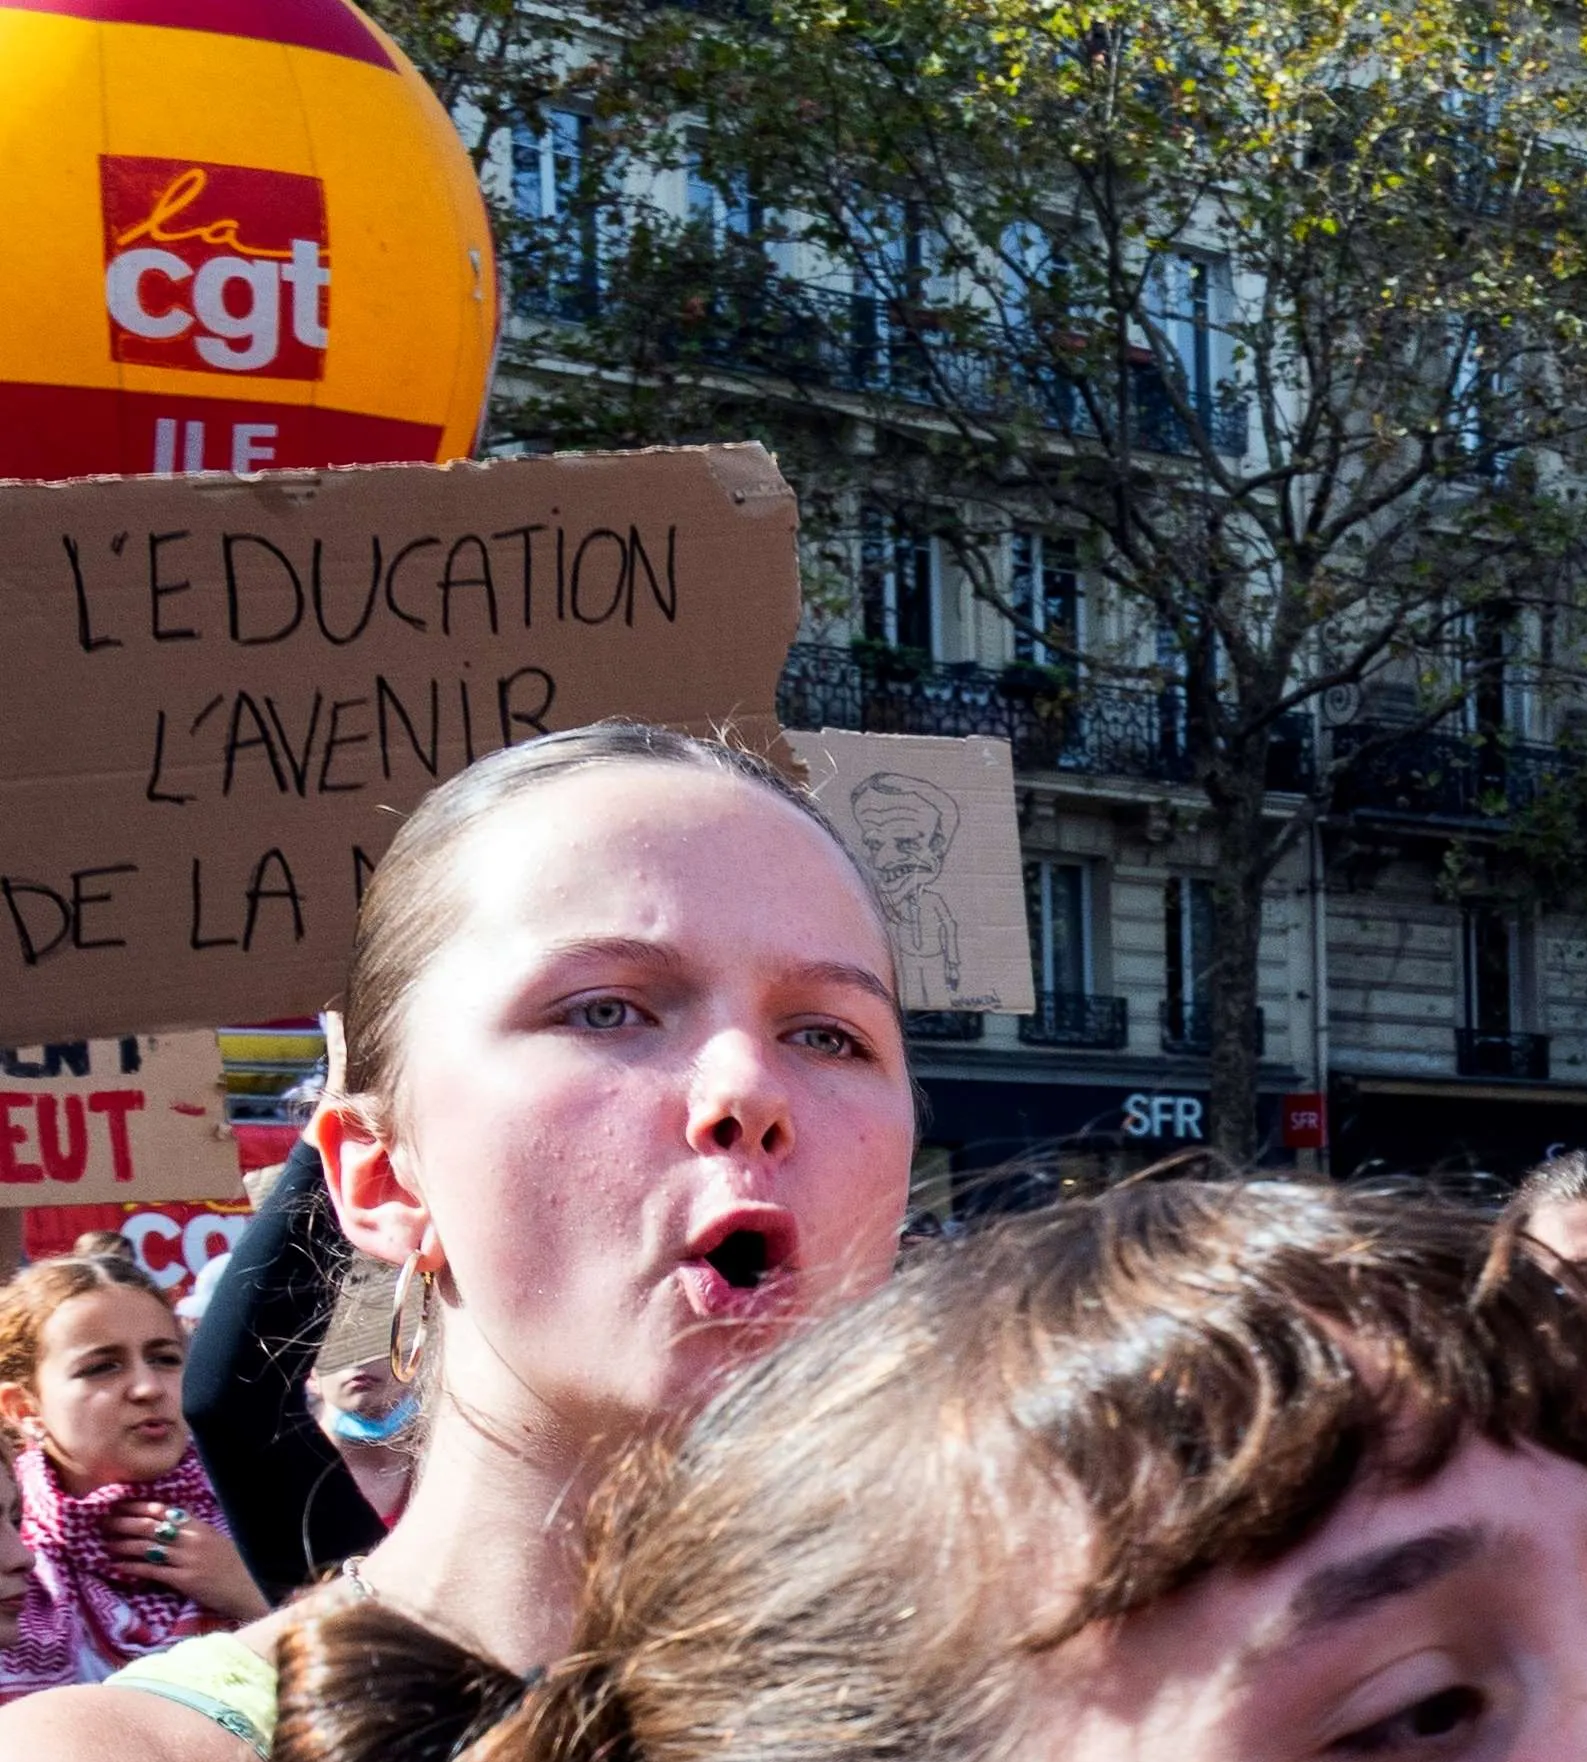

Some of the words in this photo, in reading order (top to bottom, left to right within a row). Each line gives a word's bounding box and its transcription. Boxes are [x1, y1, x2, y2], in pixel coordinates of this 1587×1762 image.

[117, 168, 330, 257] la
[106, 238, 330, 371] cgt
[62, 507, 677, 651] L'EDUCATION
[1, 864, 138, 966] DE
[190, 848, 305, 952] LA
[1122, 1092, 1203, 1138] SFR
[1290, 1111, 1319, 1131] SFR
